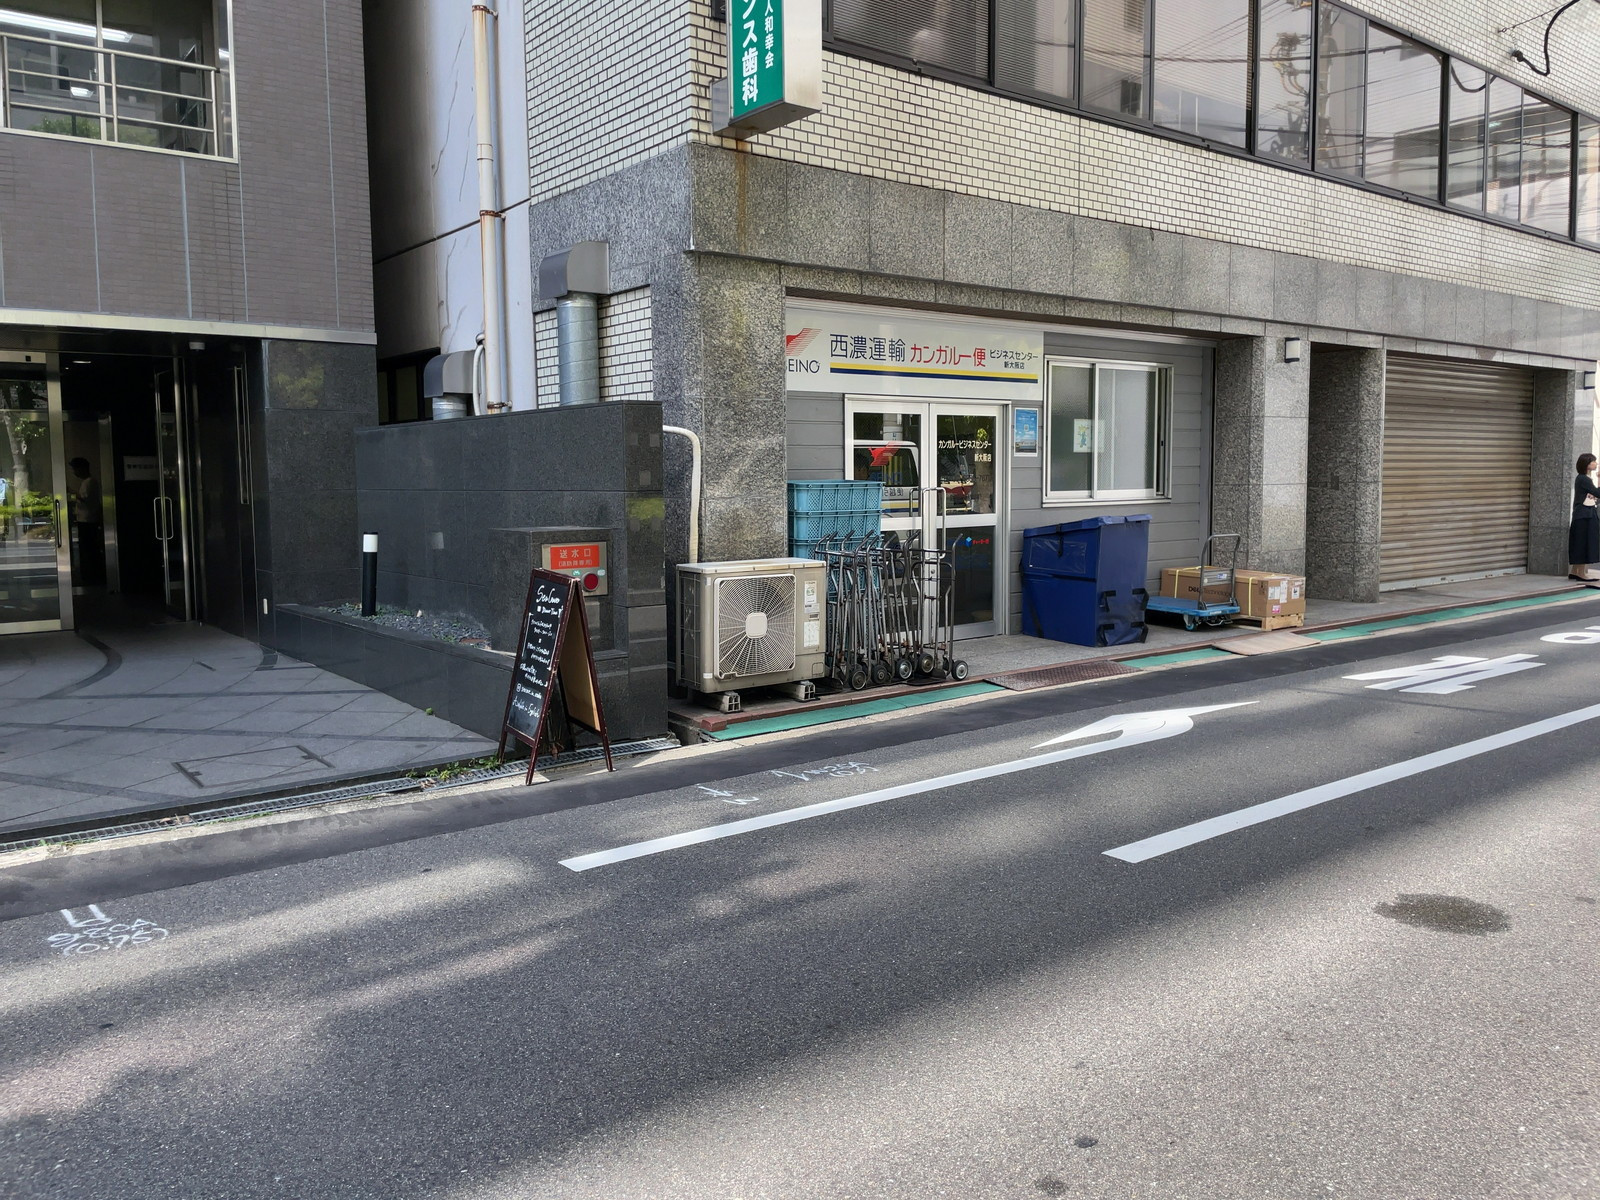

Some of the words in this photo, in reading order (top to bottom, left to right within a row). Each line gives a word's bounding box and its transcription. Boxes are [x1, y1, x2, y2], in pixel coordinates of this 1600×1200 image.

[829, 333, 906, 363] 西濃運輸
[910, 343, 986, 367] カンガルー便
[989, 349, 1039, 361] ビジネスセンター
[786, 359, 821, 374] EINO
[1003, 361, 1025, 370] 新大阪店
[938, 439, 992, 449] カンガルービジネスセンター
[559, 548, 591, 559] 送水口
